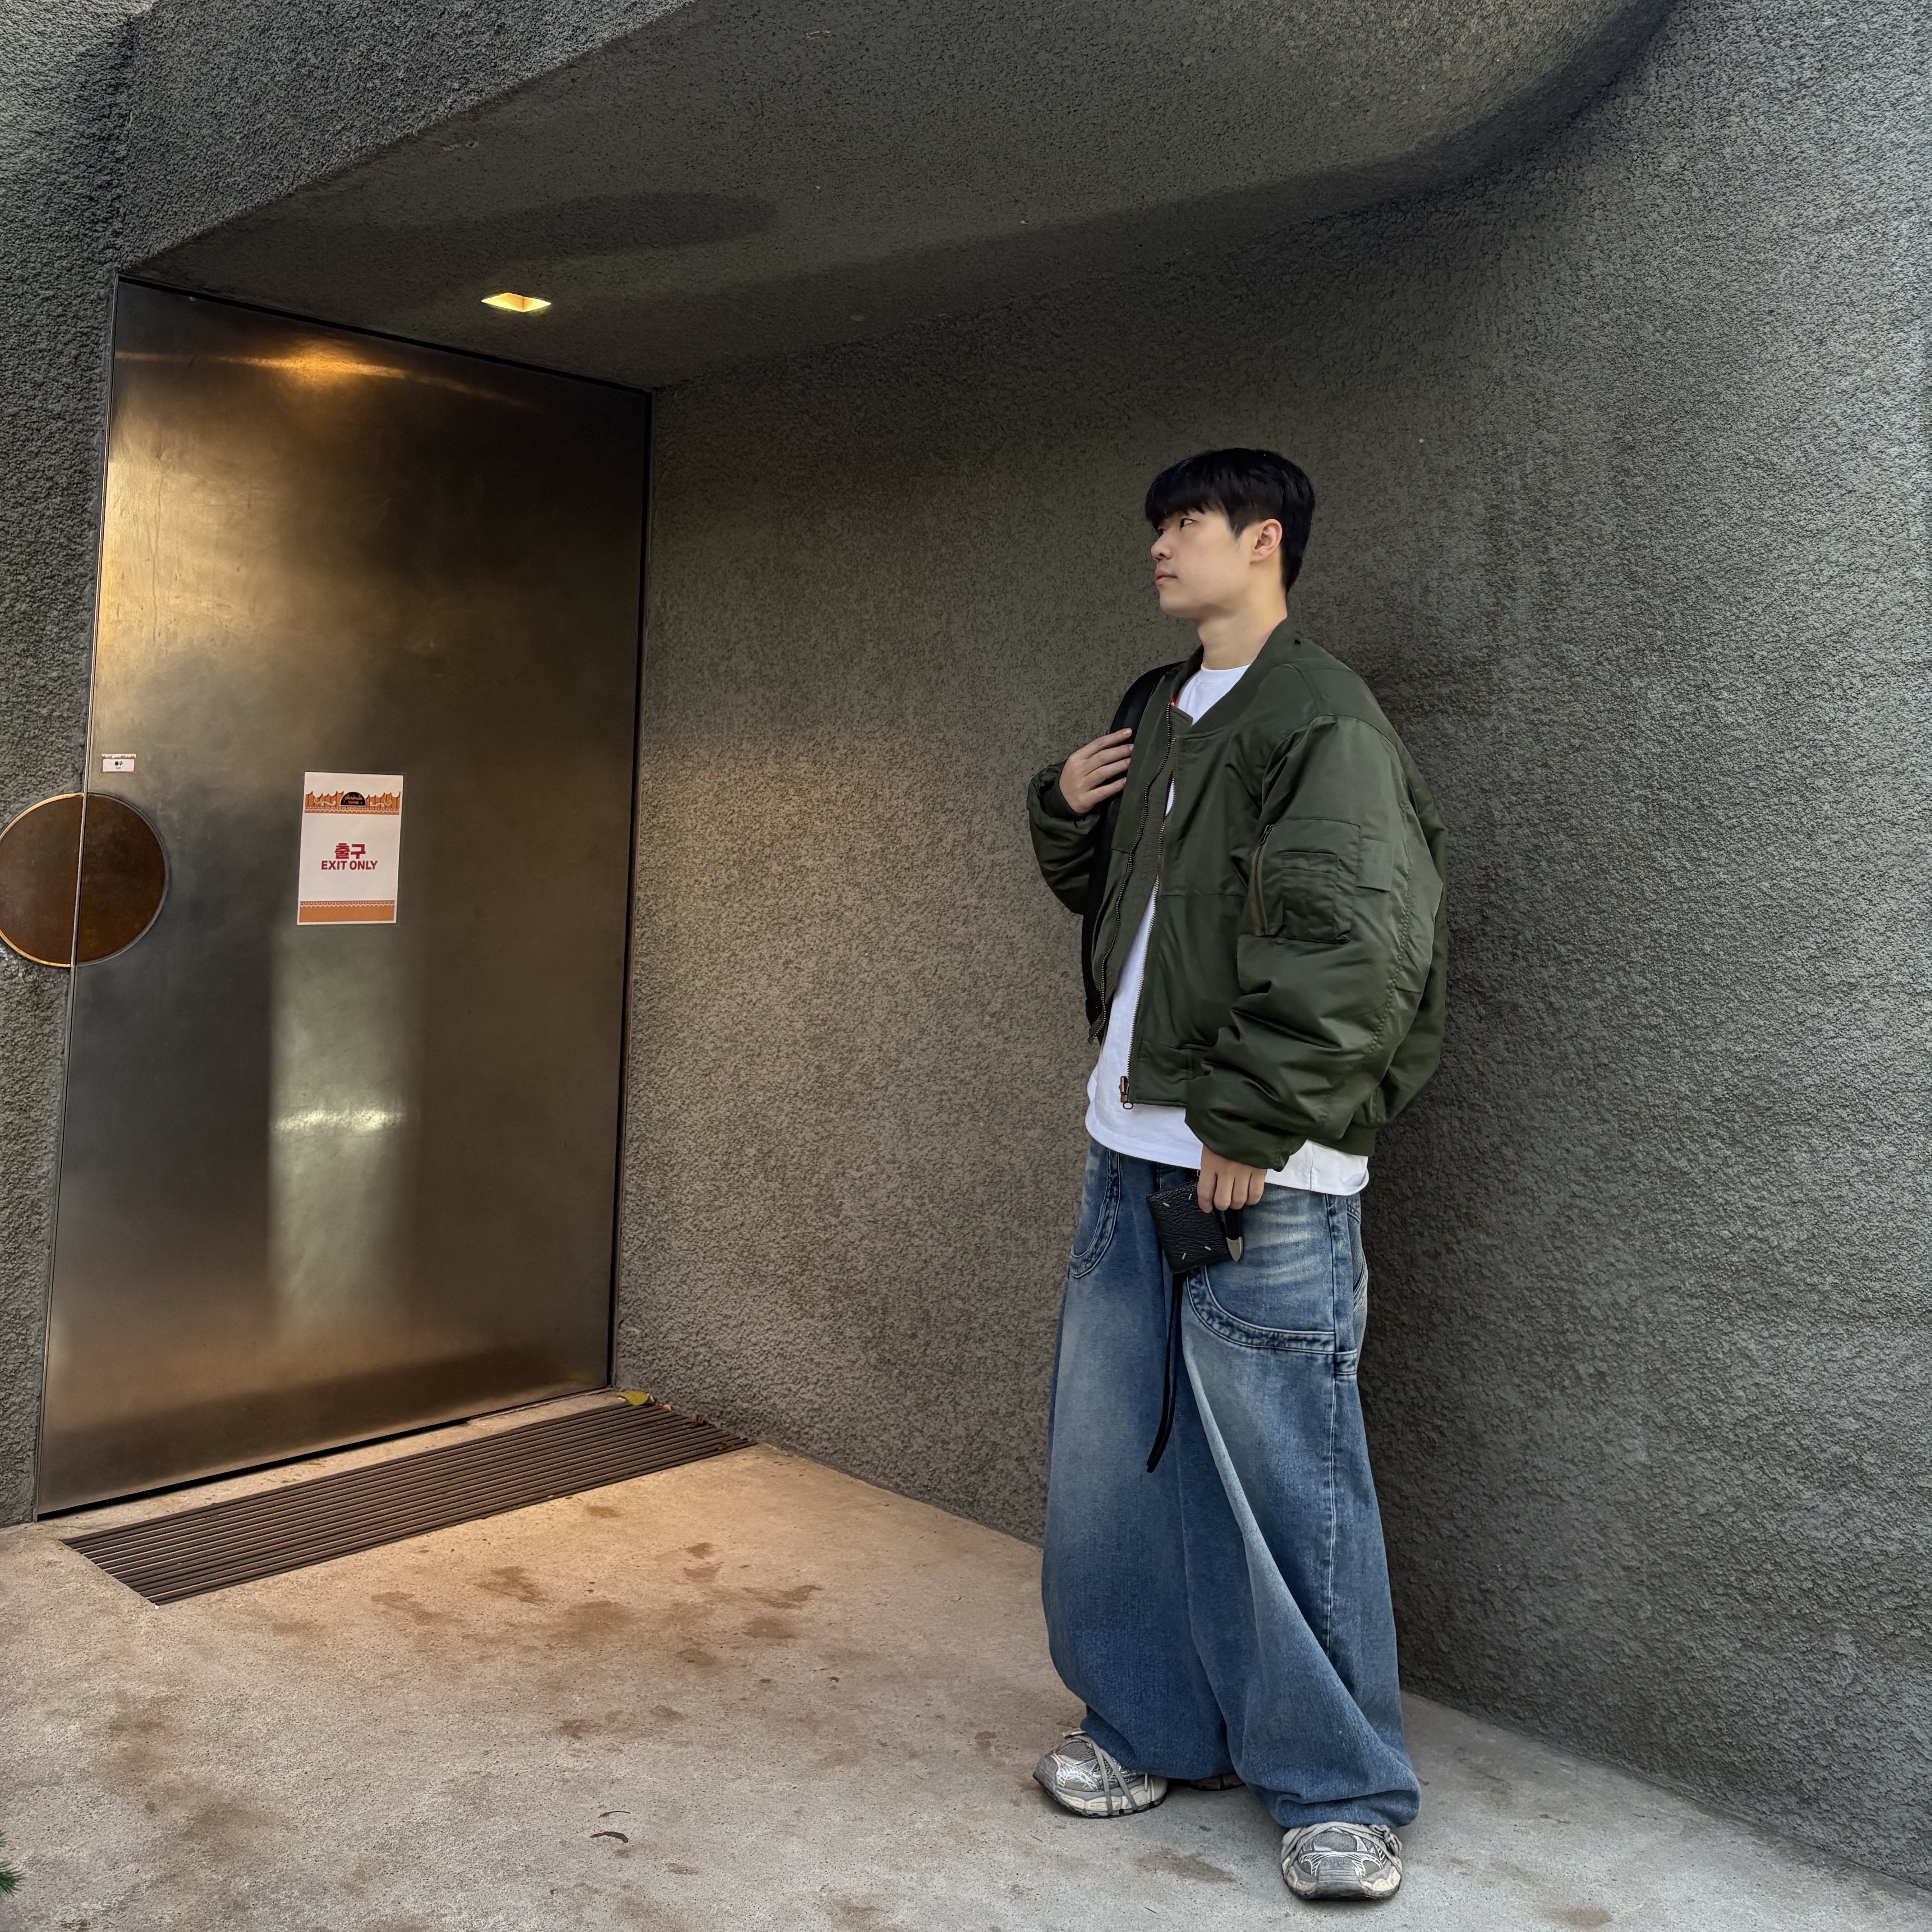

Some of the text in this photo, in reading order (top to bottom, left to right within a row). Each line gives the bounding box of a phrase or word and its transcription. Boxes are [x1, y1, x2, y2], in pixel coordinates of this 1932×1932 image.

[335, 843, 366, 859] 출구
[321, 860, 378, 870] EXIT ONLY
